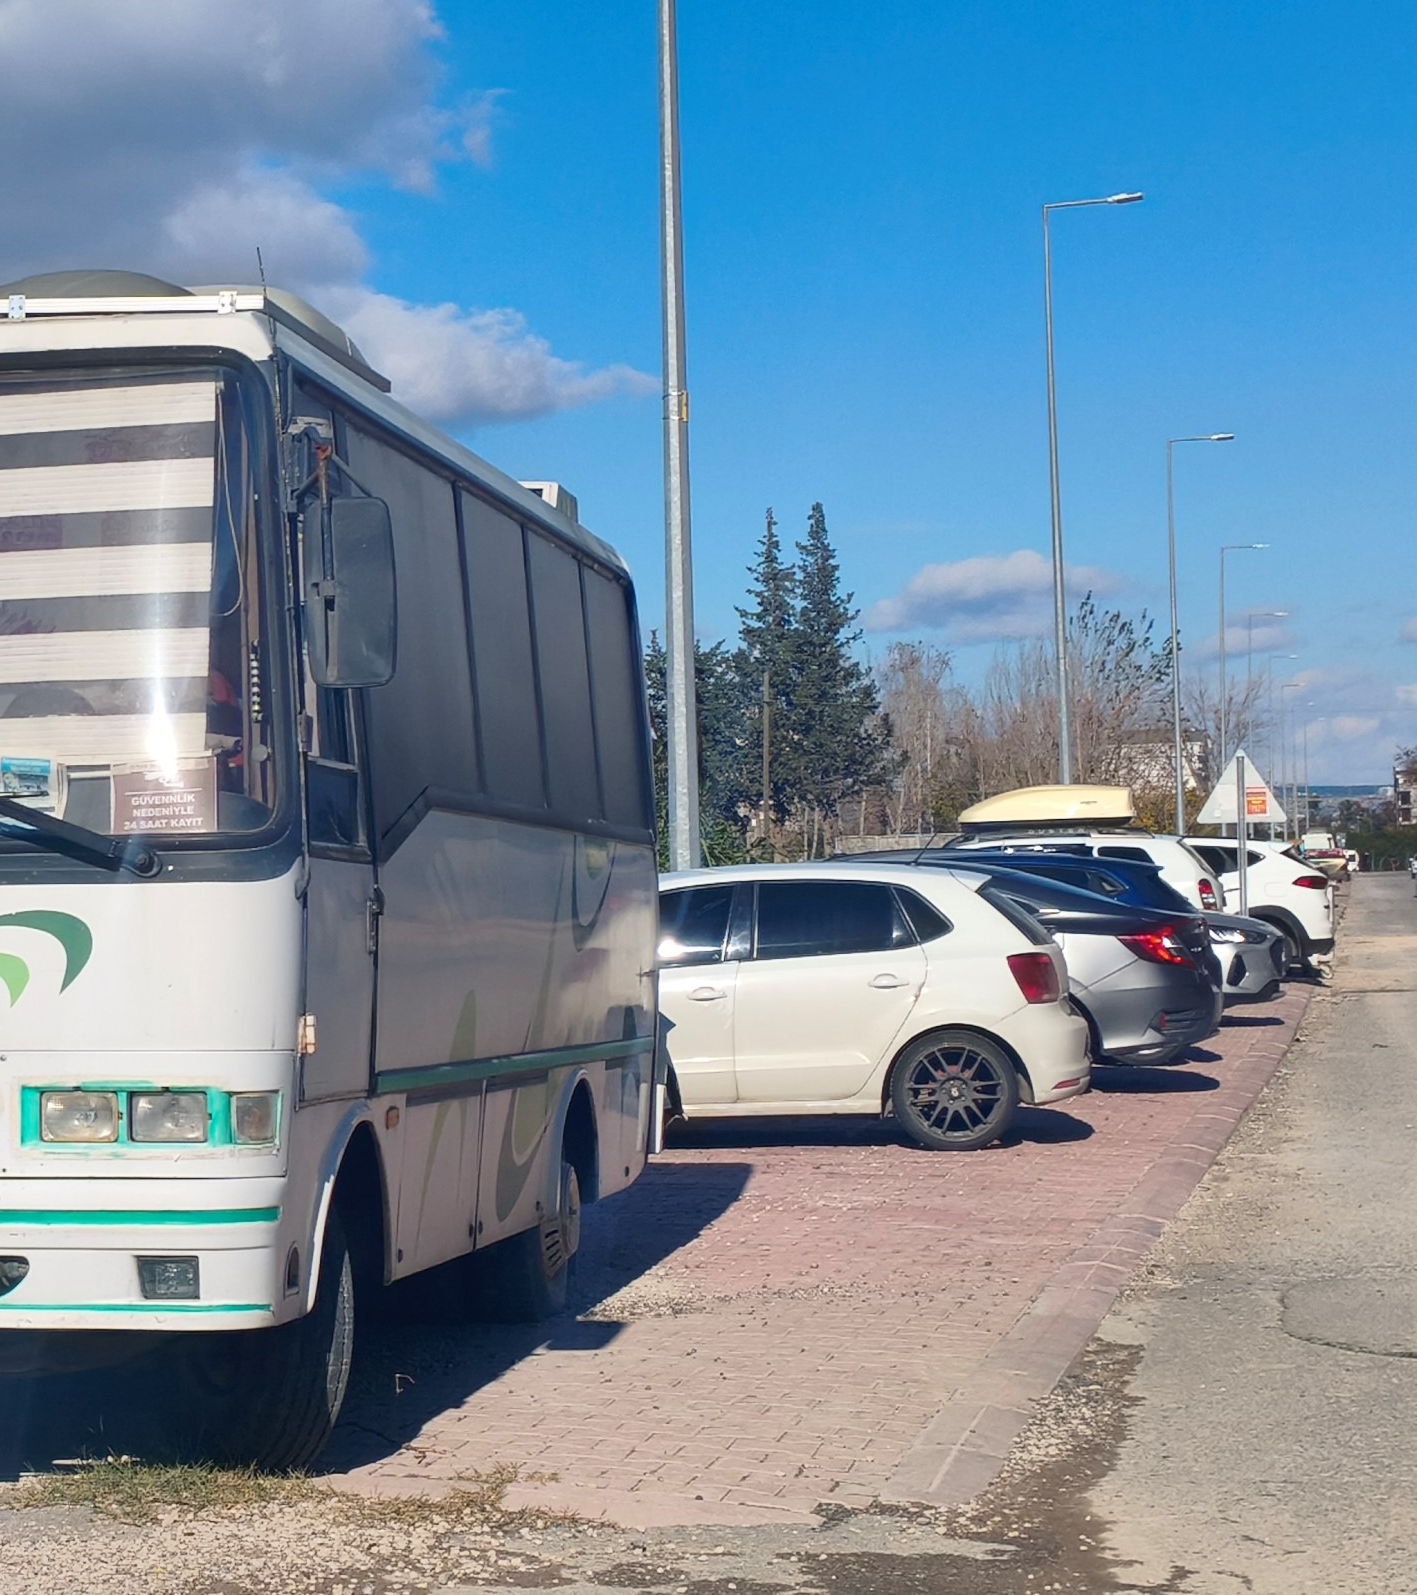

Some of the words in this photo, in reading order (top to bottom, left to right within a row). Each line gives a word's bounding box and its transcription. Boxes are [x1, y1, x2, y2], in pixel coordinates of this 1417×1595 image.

[123, 821, 137, 831] 24
[139, 820, 168, 830] SAAT
[170, 817, 204, 828] KAYIT
